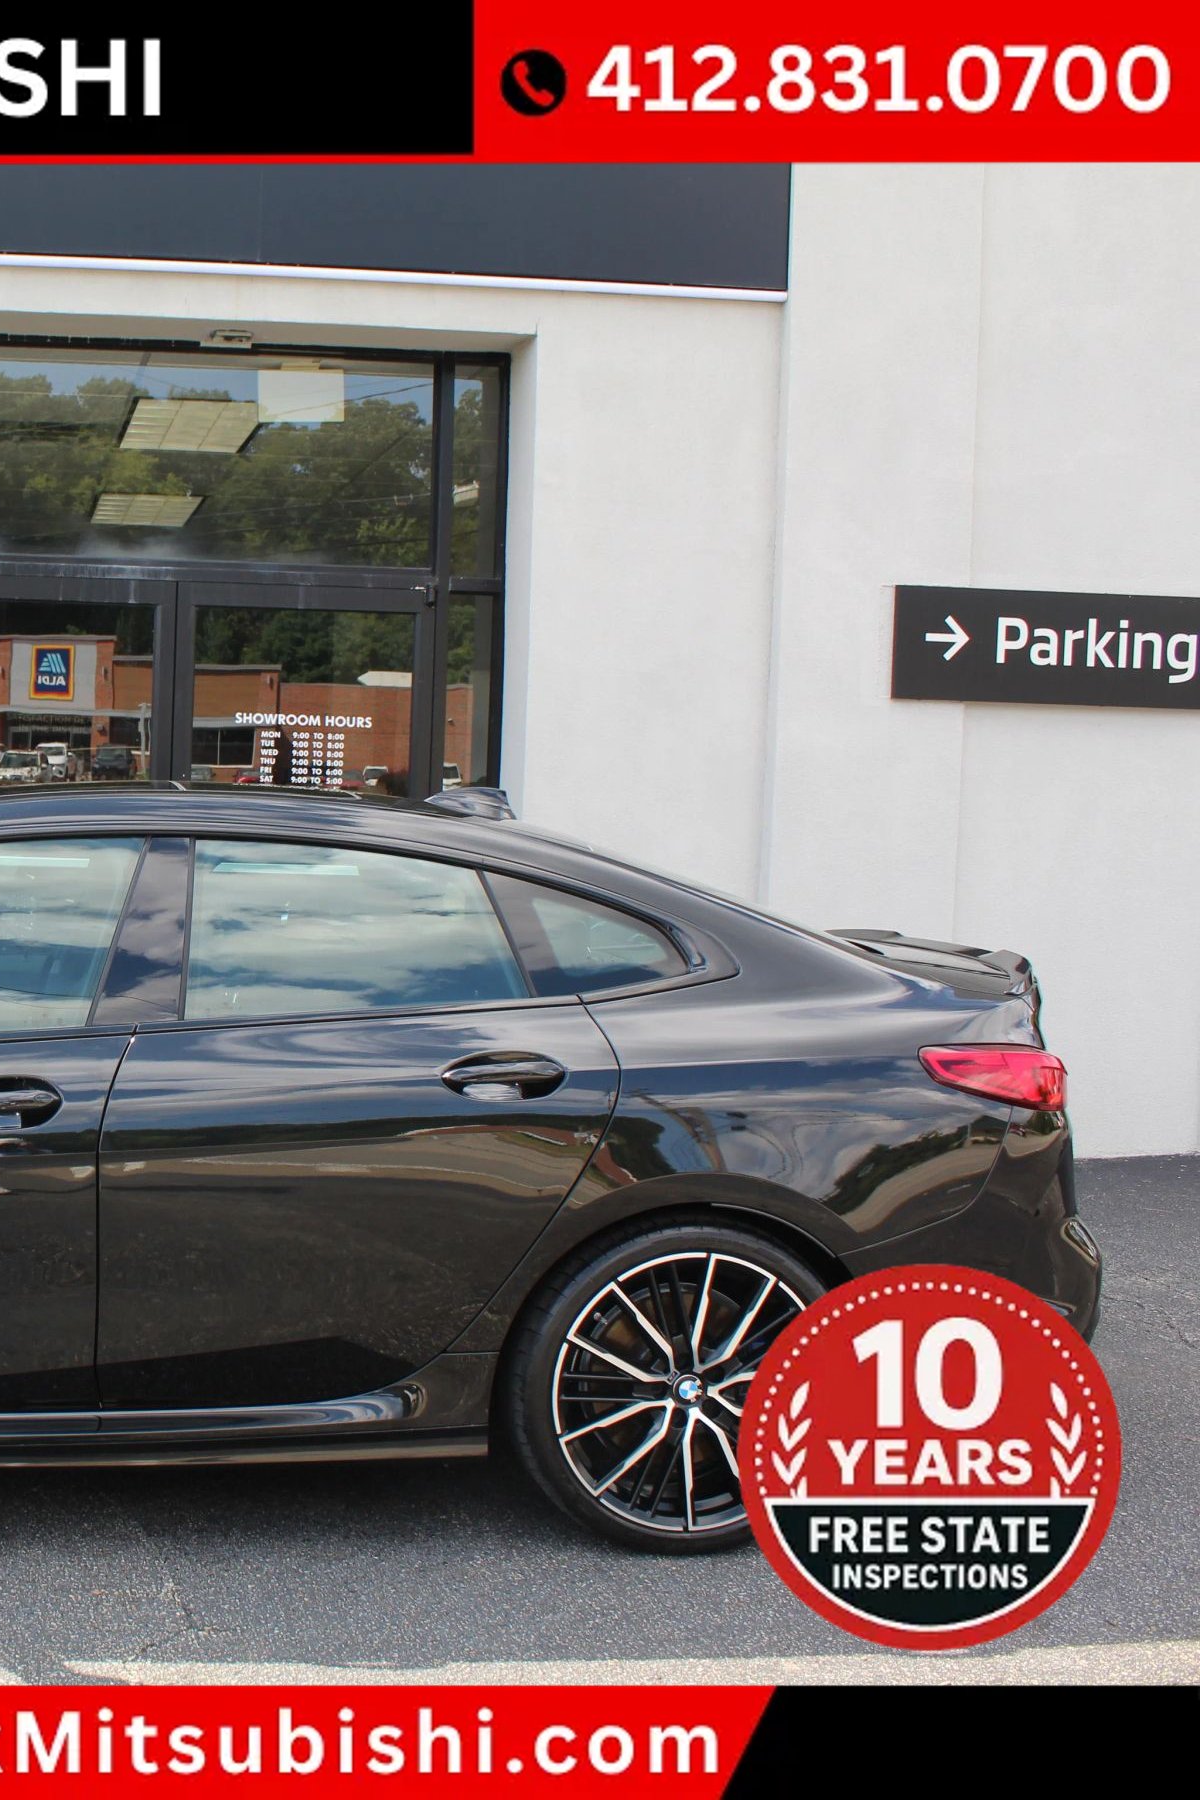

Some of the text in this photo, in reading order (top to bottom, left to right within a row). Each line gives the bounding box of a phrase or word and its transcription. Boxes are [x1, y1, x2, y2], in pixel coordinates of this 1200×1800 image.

[996, 615, 1199, 684] Parking
[234, 711, 373, 729] SHOWROOM HOURS
[260, 731, 281, 739] MON
[313, 732, 324, 740] TO
[312, 741, 323, 749] TO
[312, 750, 323, 758] TO
